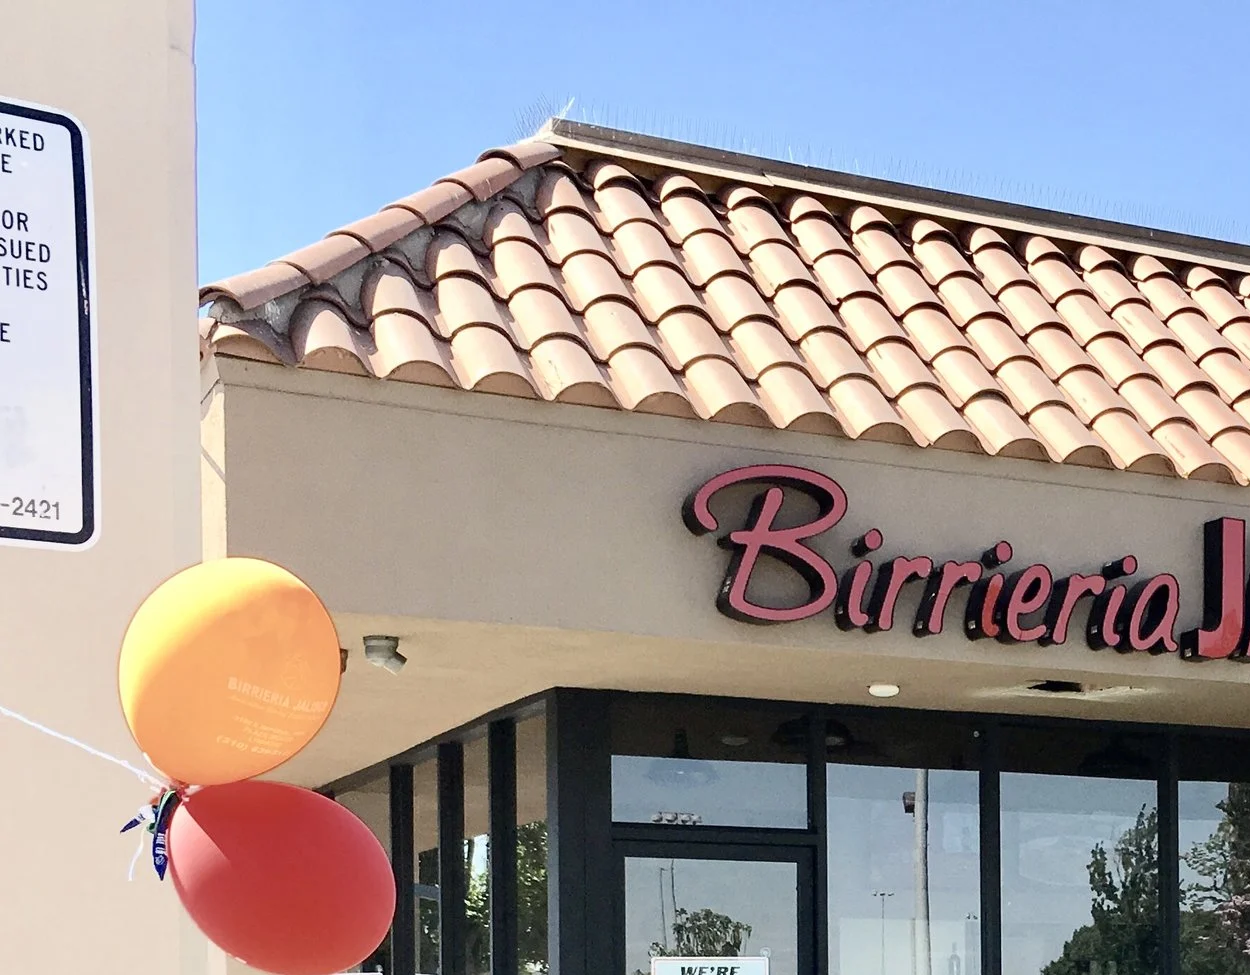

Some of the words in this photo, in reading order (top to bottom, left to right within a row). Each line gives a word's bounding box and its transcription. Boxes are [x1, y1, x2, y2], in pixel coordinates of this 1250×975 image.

[0, 126, 45, 151] KED
[2, 209, 29, 232] OR
[2, 266, 48, 291] TIES
[684, 464, 1178, 653] Birrieria
